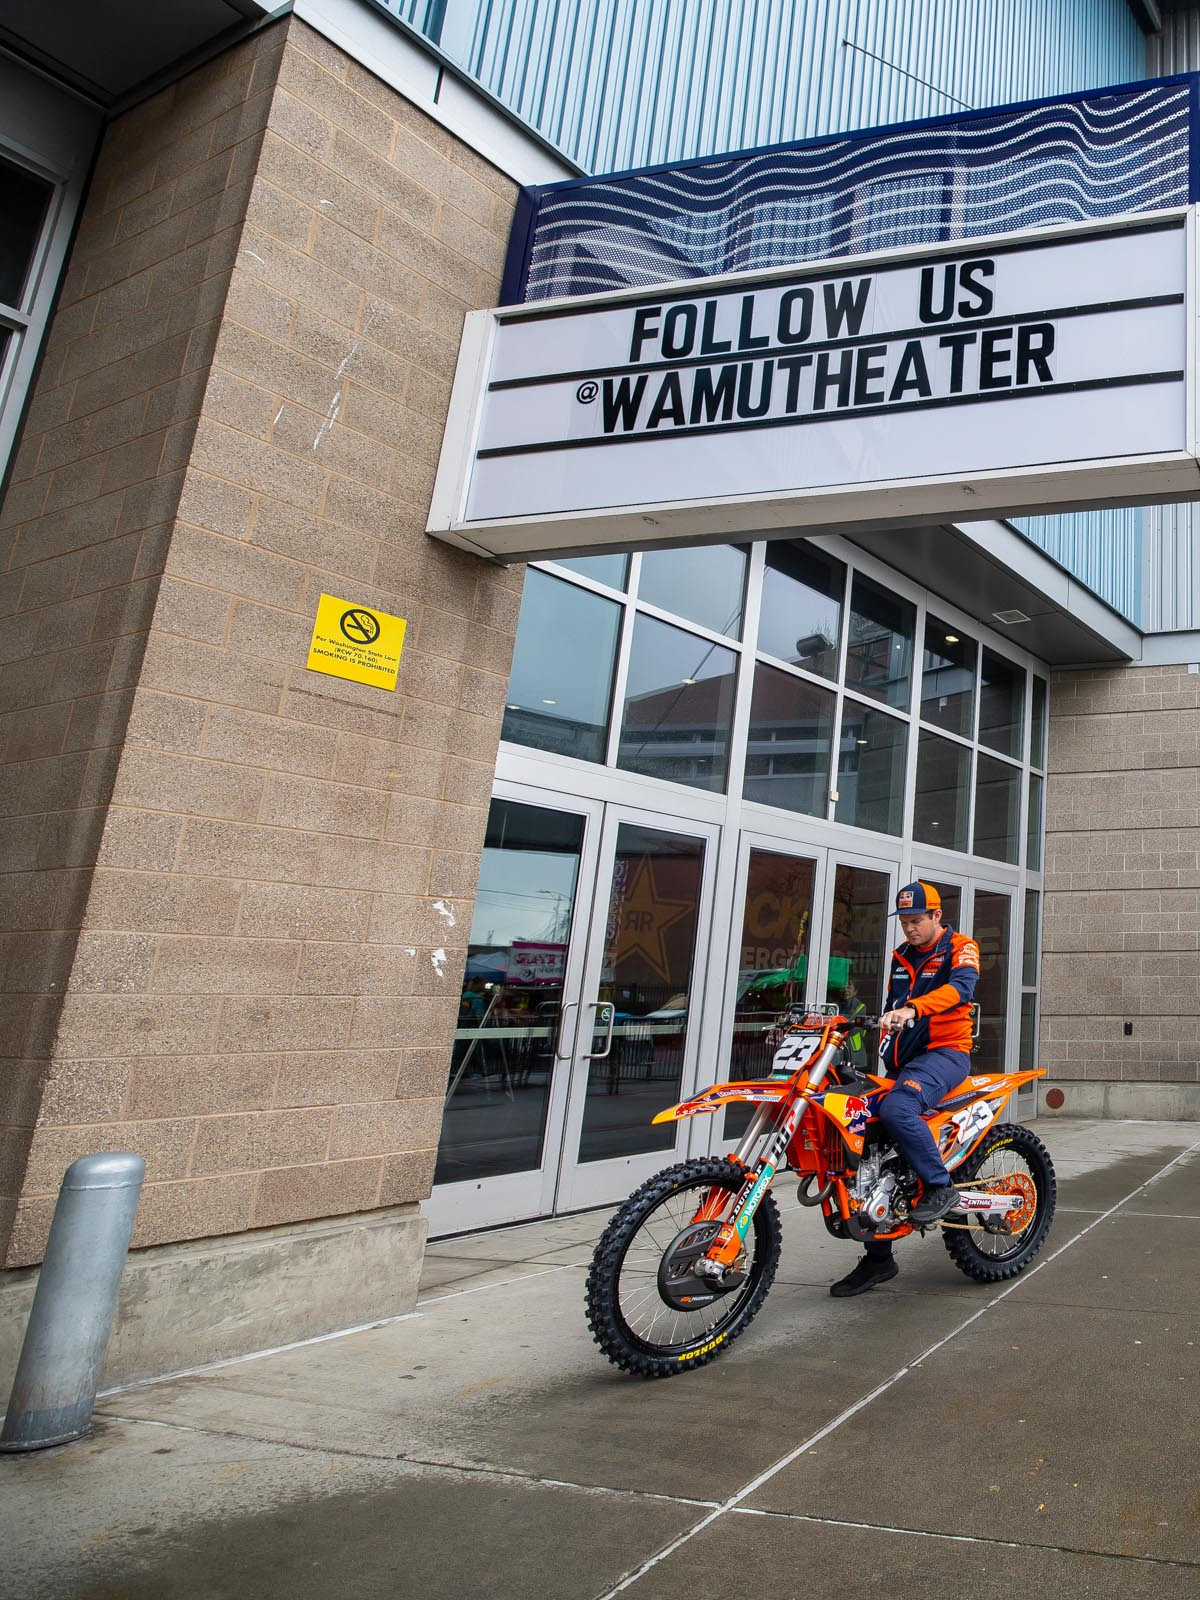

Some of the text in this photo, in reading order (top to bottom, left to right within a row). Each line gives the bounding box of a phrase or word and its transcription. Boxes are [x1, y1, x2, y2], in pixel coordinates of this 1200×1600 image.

[628, 258, 996, 363] FOLLOW US
[575, 321, 1057, 434] @WAMUTHEATER
[313, 647, 396, 675] SMOKING IS PROHIBITED
[315, 634, 327, 643] Per
[328, 636, 367, 654] Washington
[367, 649, 383, 659] State
[772, 1036, 821, 1071] 23
[951, 1099, 994, 1145] 23
[744, 1173, 771, 1217] MOTOREX
[678, 1334, 724, 1362] DUNLOP
